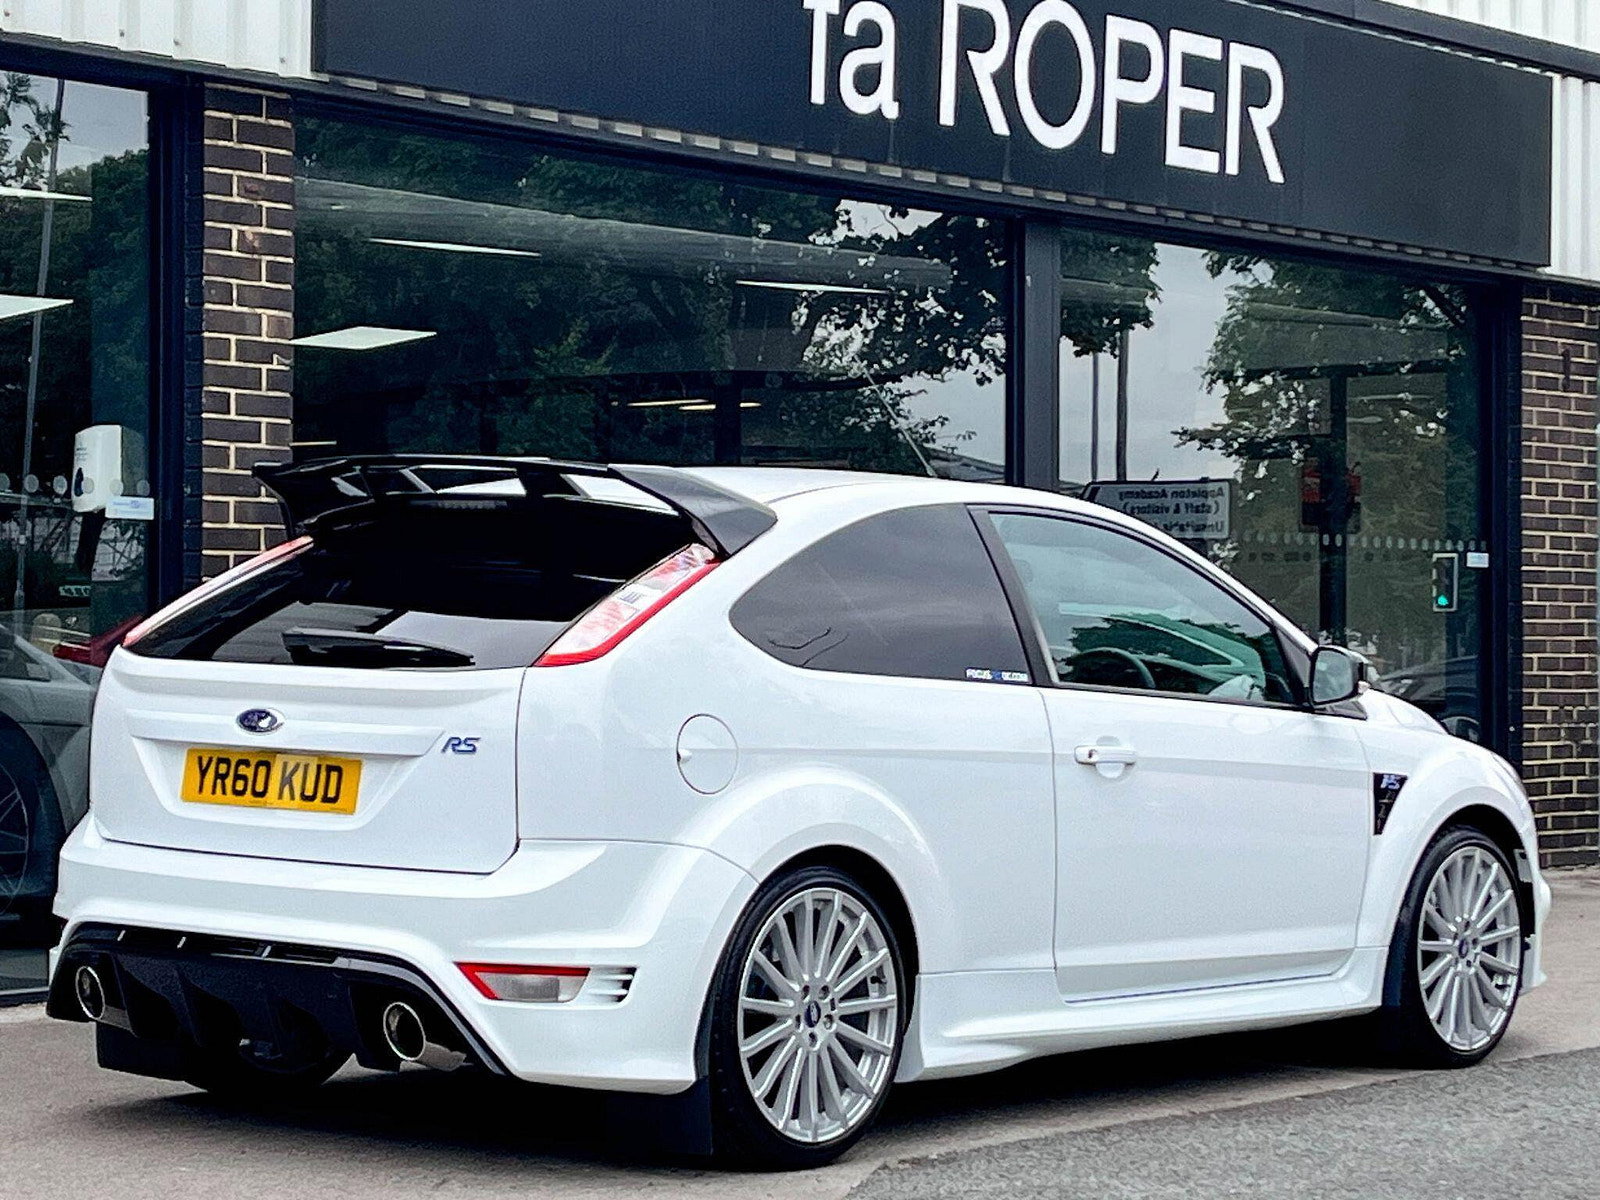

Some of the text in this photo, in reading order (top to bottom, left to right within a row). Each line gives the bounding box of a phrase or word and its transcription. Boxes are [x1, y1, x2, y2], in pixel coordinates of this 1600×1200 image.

[938, 0, 1286, 184] ROPER
[441, 736, 482, 754] RS
[196, 755, 344, 805] YR60 KUD
